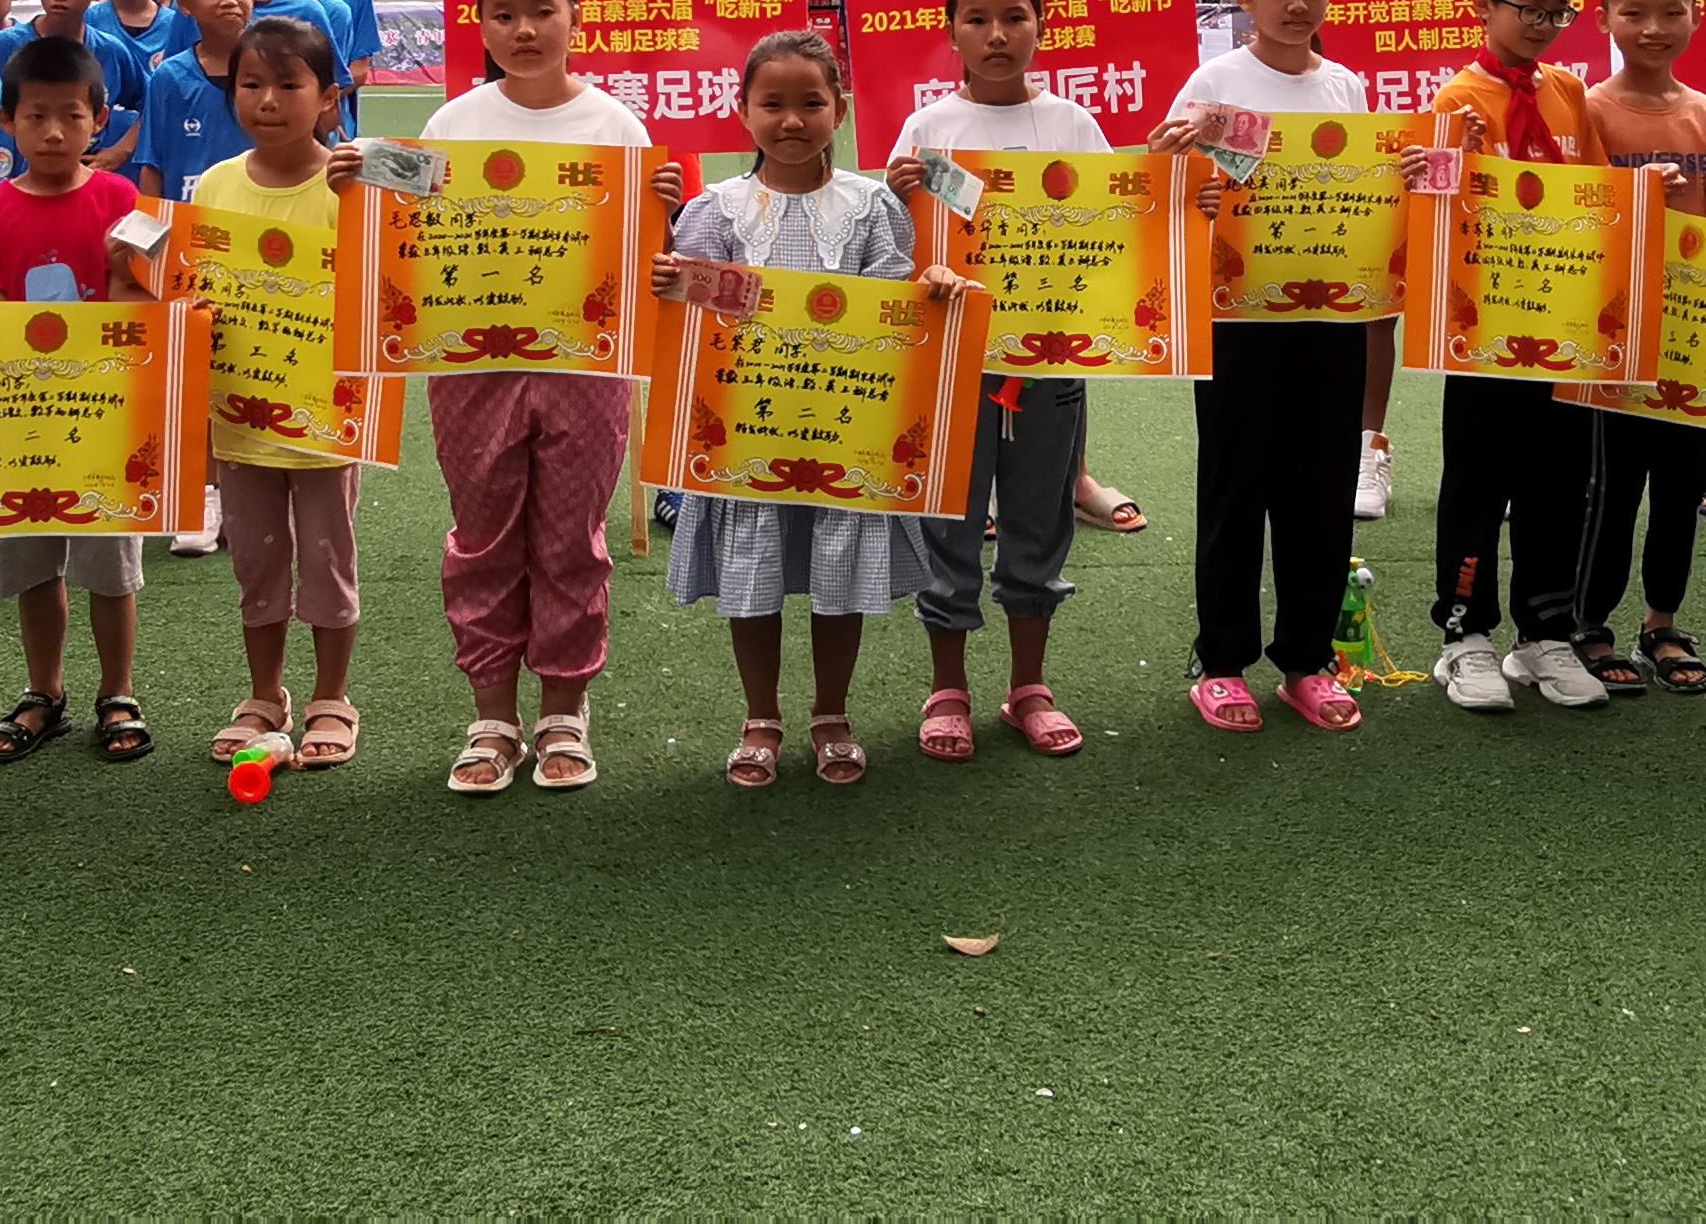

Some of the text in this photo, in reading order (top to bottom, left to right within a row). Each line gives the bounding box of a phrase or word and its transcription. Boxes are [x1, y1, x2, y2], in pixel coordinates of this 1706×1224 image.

[569, 27, 700, 53] 四人制足球赛
[1038, 25, 1096, 51] 足球赛
[1375, 26, 1485, 53] 四人制足球
[440, 263, 545, 288] 第一名
[753, 396, 853, 425] 第二名
